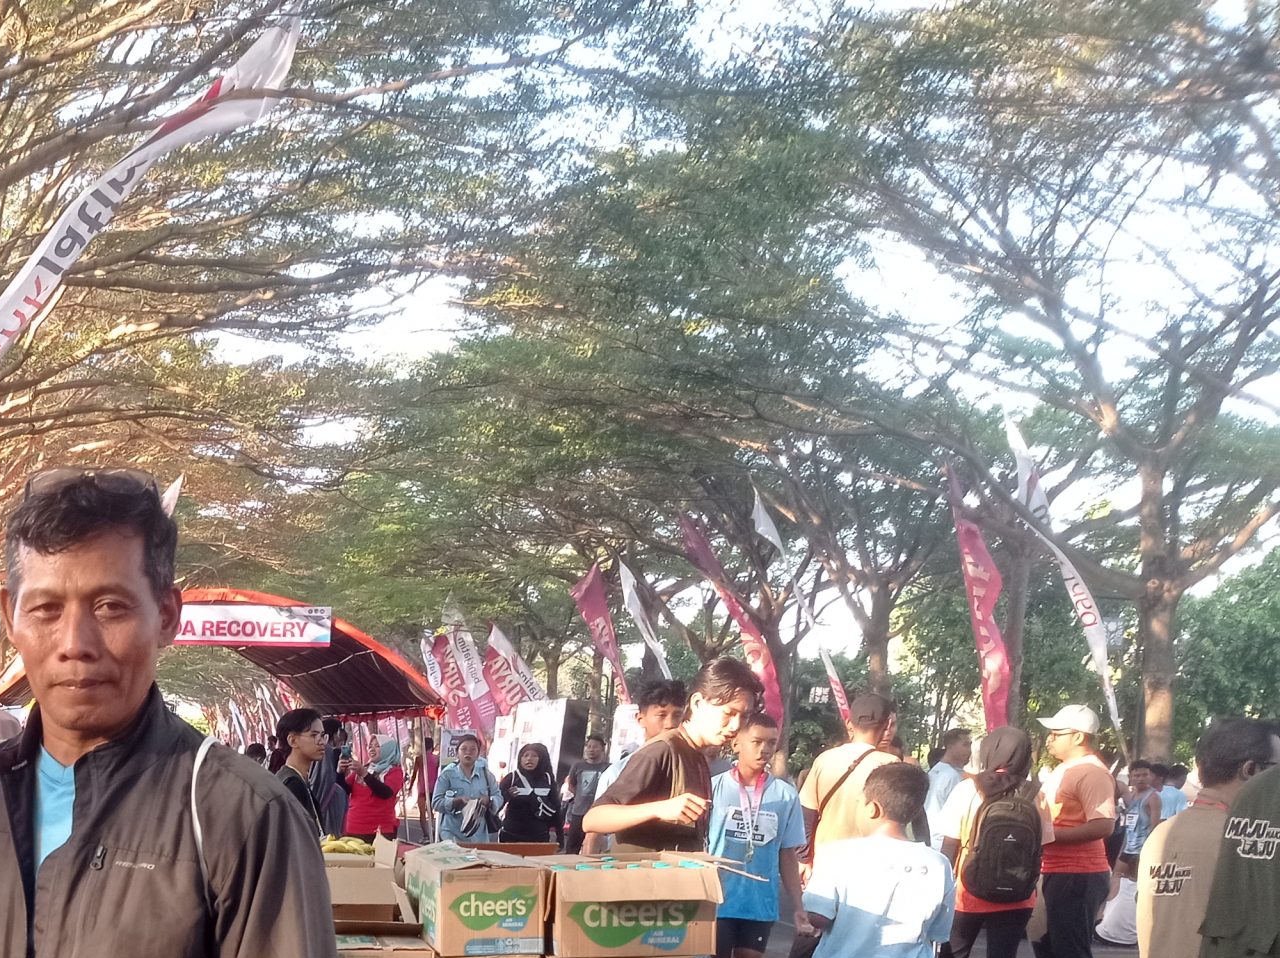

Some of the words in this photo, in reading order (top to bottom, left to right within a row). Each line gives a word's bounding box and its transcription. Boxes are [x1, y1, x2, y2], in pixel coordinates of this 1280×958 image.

[201, 620, 309, 638] RECOVERY
[1225, 817, 1269, 840] MAJU
[1240, 839, 1276, 858] LAJU
[1155, 879, 1183, 895] LAJU
